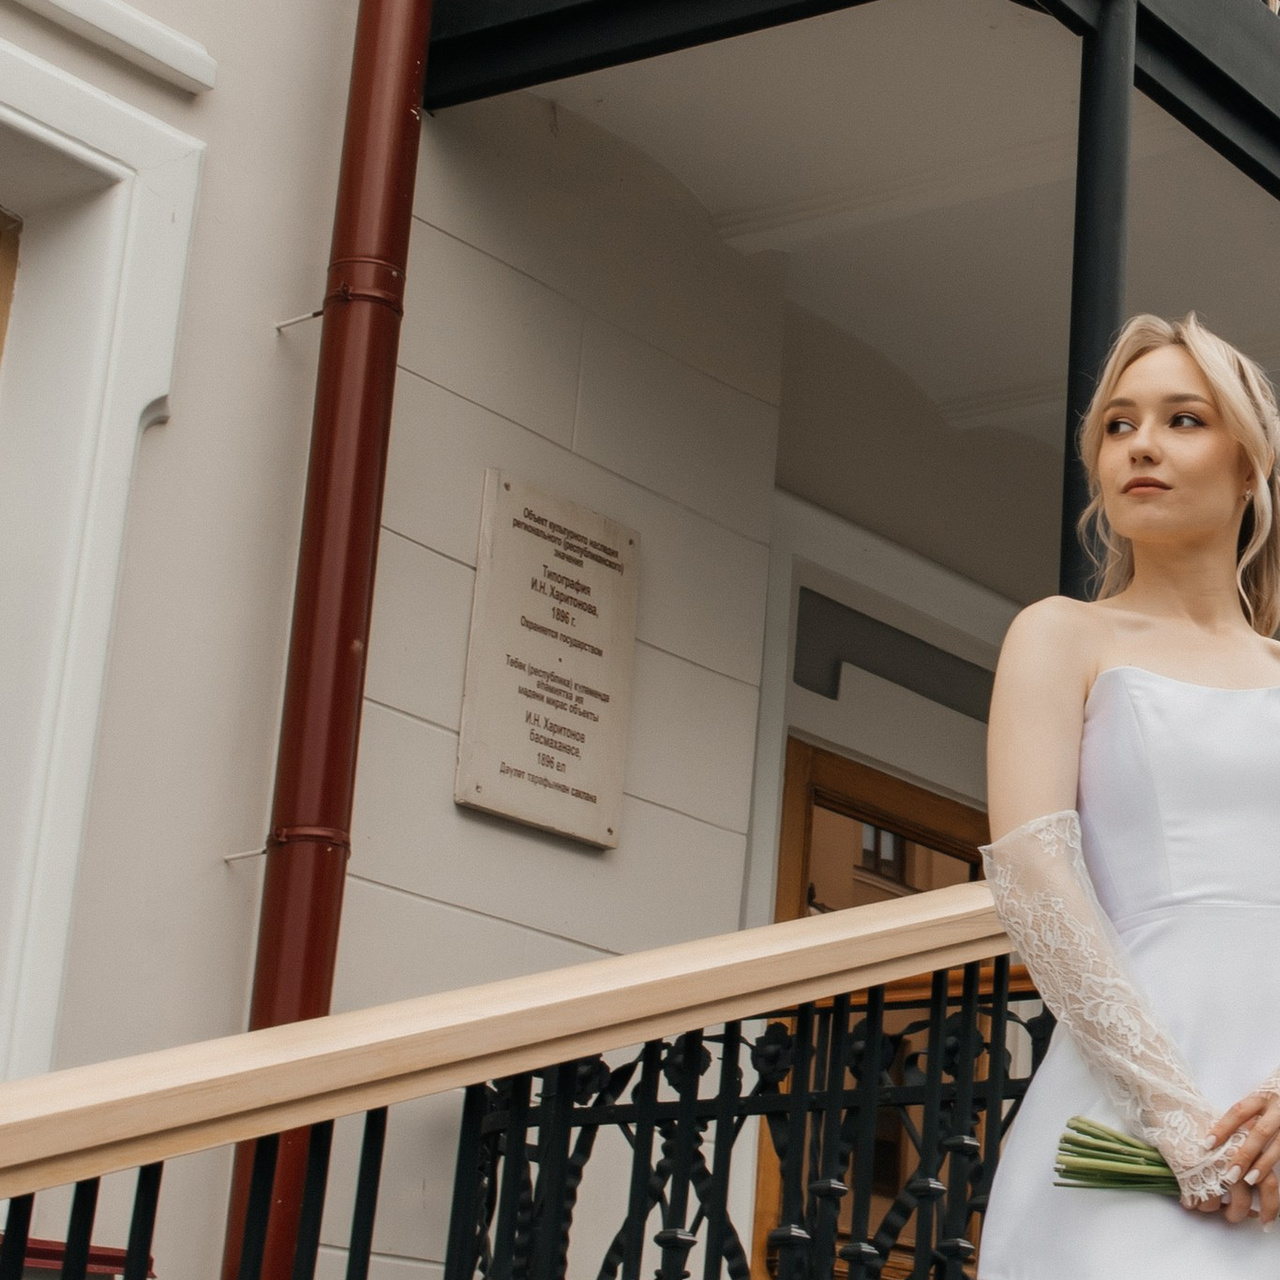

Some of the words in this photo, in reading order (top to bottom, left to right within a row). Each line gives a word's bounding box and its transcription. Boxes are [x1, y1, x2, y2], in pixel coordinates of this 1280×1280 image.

[523, 507, 548, 527] Объект
[554, 548, 584, 568] значения
[543, 564, 591, 596] Типография
[531, 577, 547, 595] И.Н.
[549, 585, 599, 618] Харитонова,
[552, 606, 570, 625] 1896
[571, 617, 576, 627] г.
[521, 615, 559, 639] Охраняется
[560, 633, 603, 657] государством
[569, 703, 599, 722] объекты
[525, 710, 541, 727] И.Н.
[543, 716, 586, 744] Харитонов
[538, 752, 555, 769] 1896
[556, 761, 566, 773] ел
